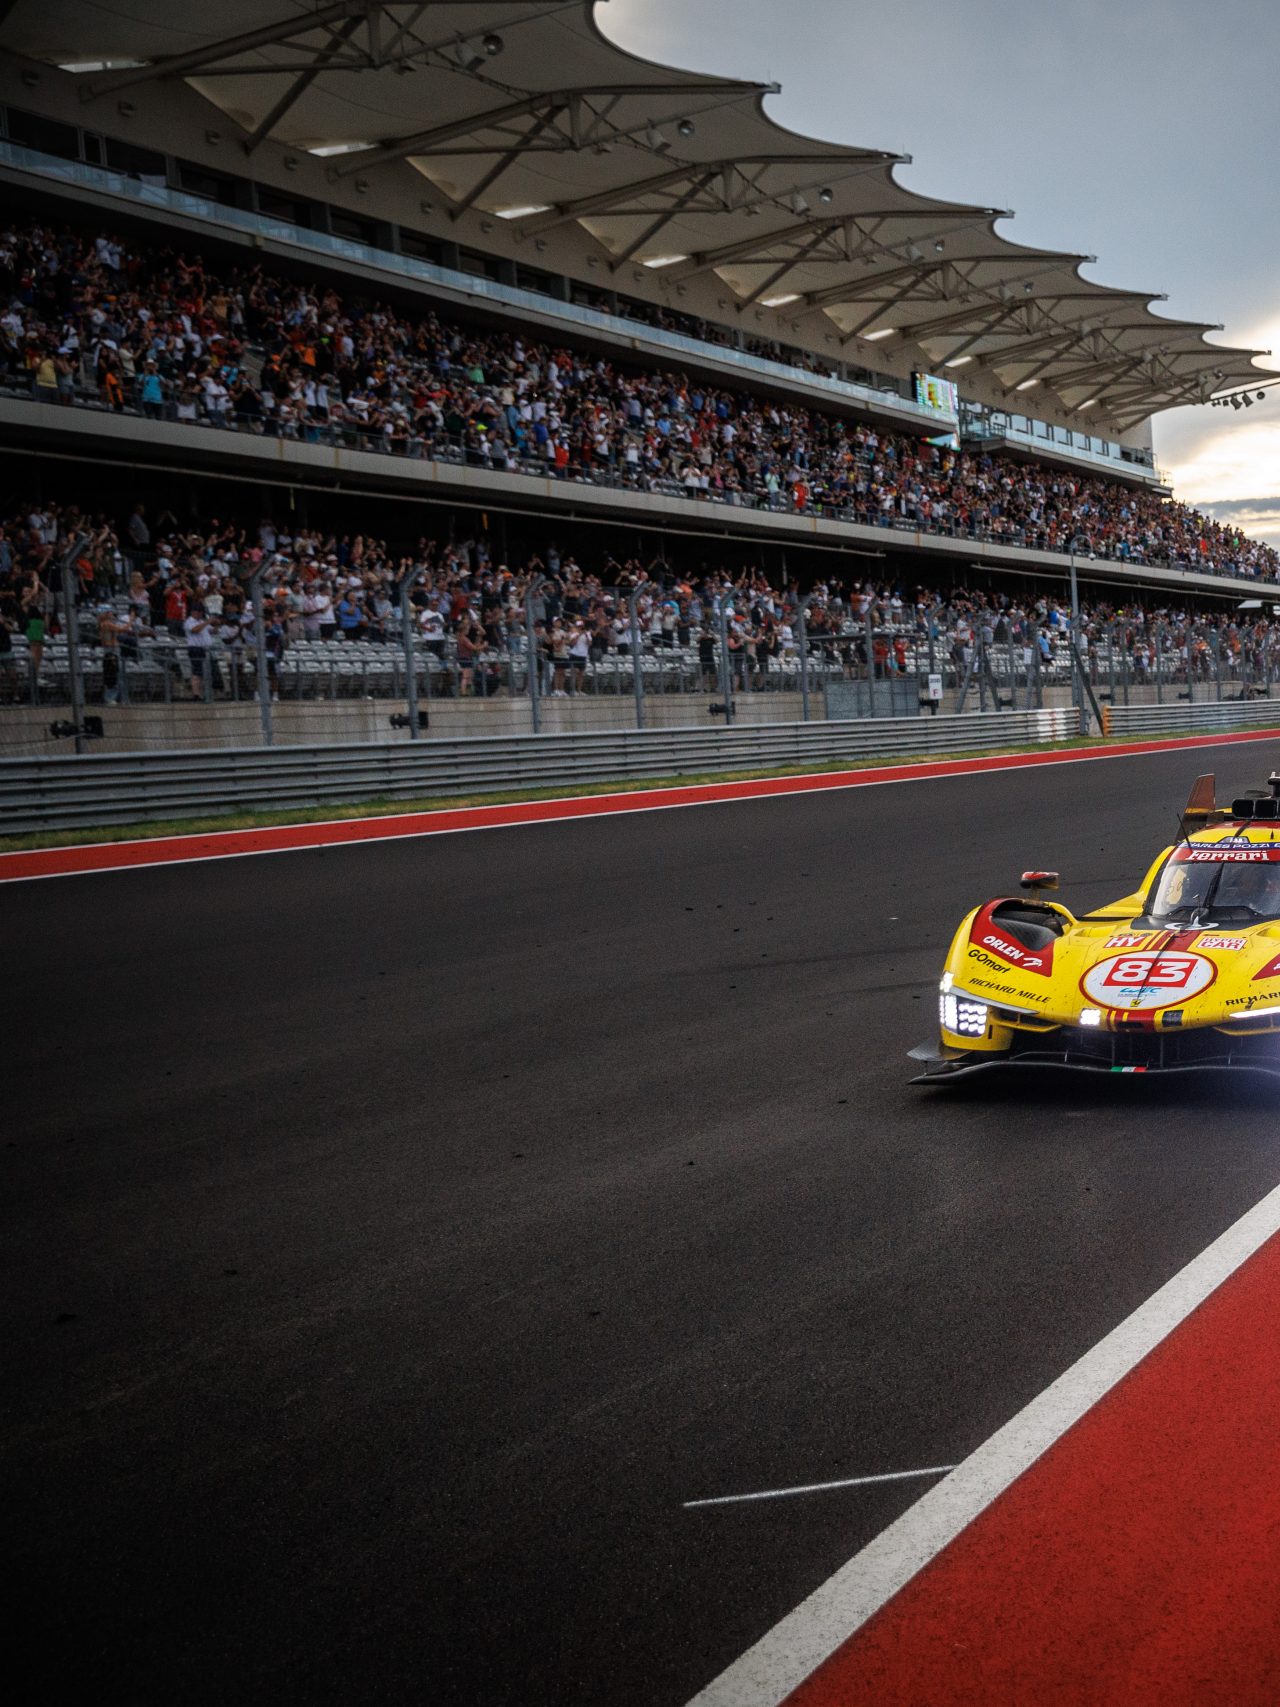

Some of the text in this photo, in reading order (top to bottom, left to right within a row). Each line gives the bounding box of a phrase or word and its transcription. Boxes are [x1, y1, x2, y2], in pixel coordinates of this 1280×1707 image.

[1186, 849, 1270, 861] Ferrari
[983, 935, 1025, 960] ORLEN
[1105, 937, 1143, 948] HY
[1200, 941, 1240, 950] CAR
[968, 949, 1011, 974] GOmart
[1111, 961, 1191, 983] 83
[968, 977, 1053, 1004] RICHARD MILLE
